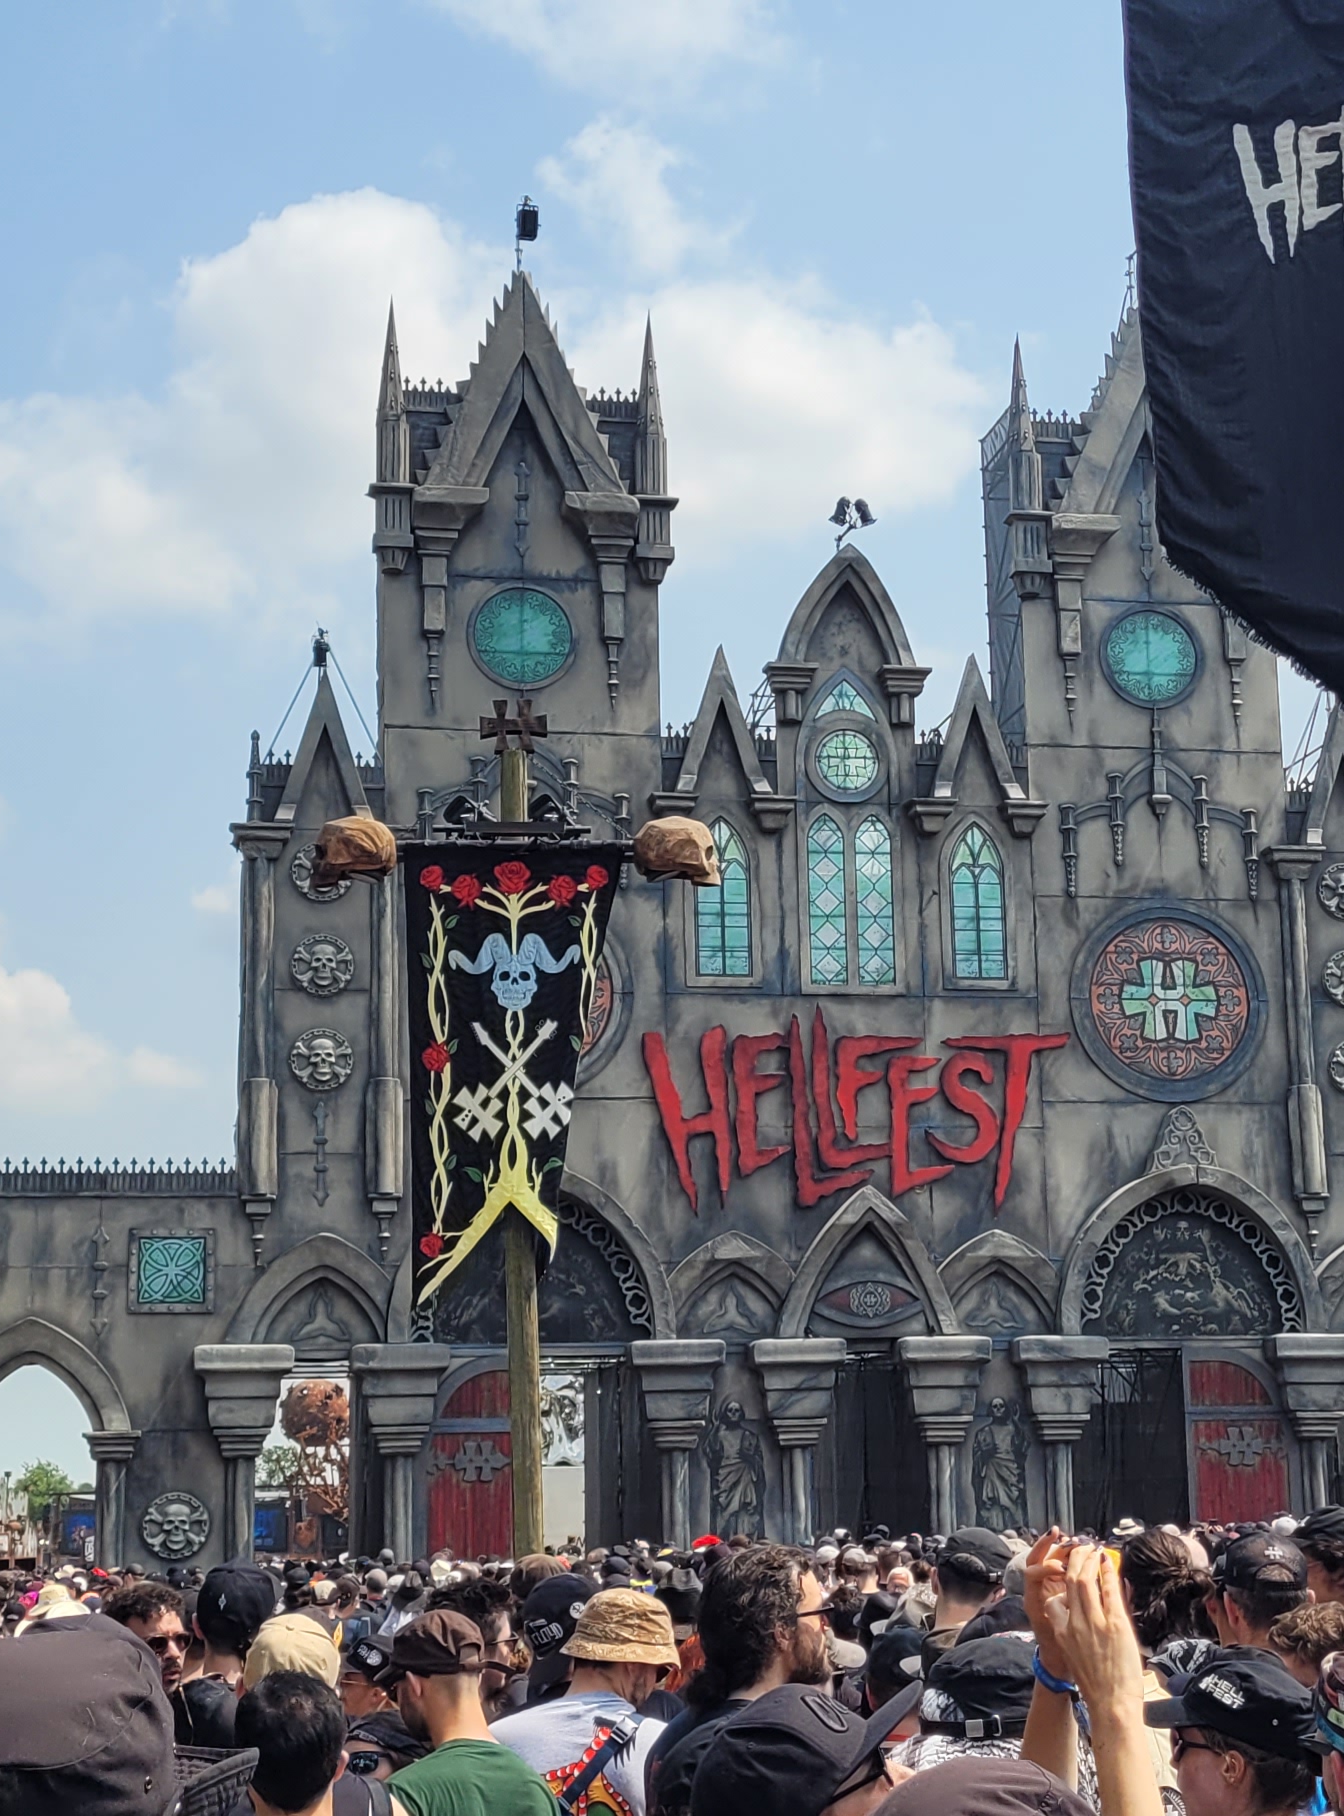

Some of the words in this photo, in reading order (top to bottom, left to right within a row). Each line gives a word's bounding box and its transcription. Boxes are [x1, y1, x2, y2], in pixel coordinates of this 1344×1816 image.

[642, 1003, 1070, 1217] HELLFEST
[1206, 1683, 1244, 1709] FEST
[1211, 1675, 1245, 1702] HELL
